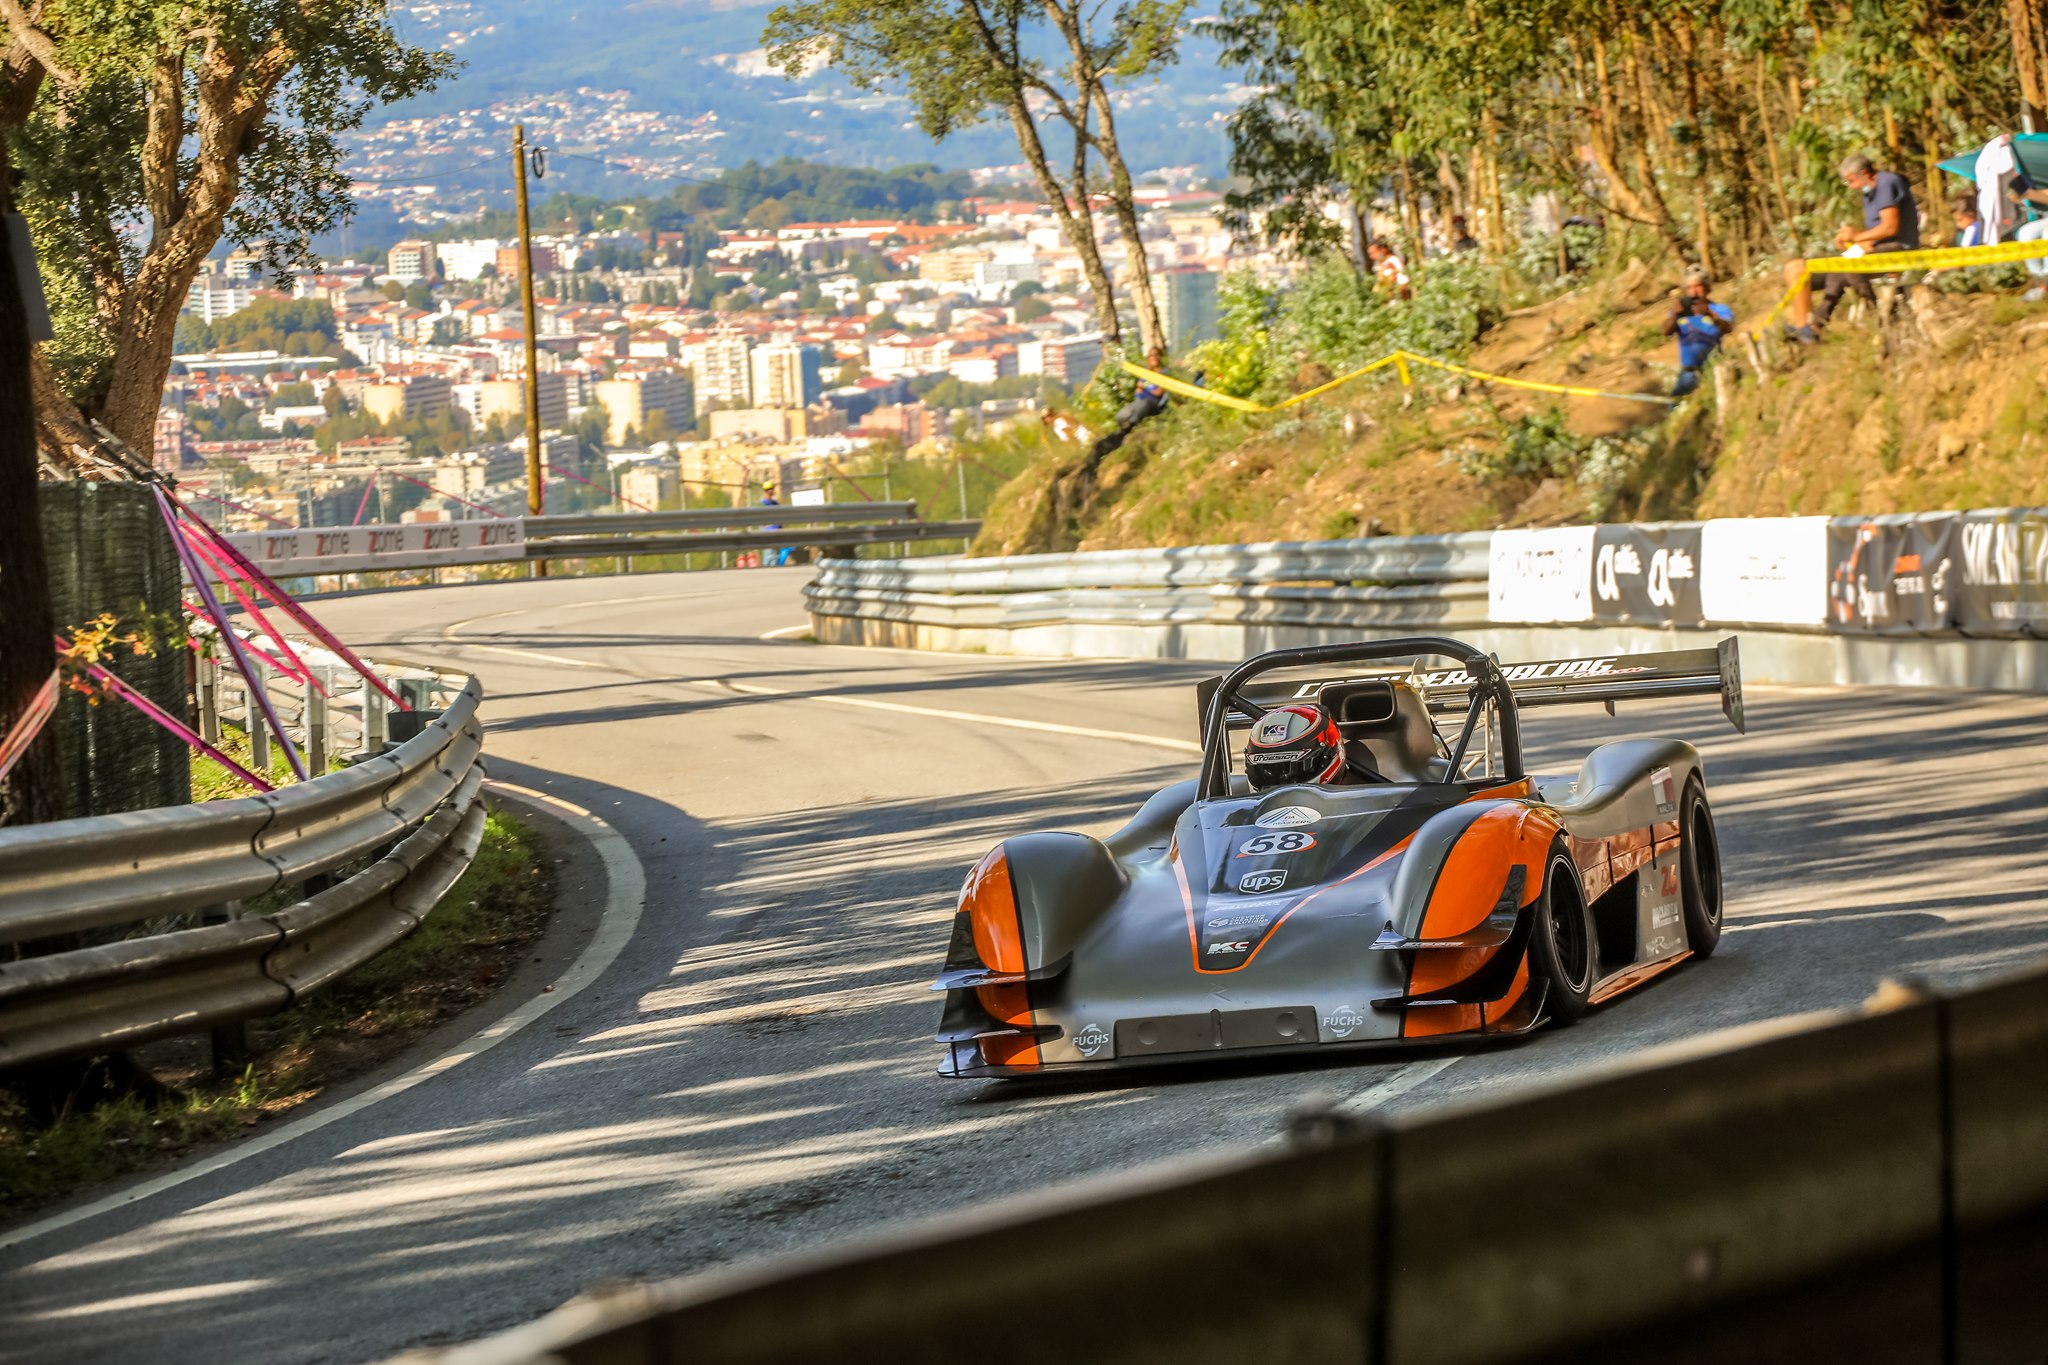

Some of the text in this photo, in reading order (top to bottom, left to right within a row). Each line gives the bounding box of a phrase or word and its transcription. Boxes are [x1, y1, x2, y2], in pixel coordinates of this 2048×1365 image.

[1247, 833, 1305, 854] 58
[1242, 875, 1283, 891] ups
[1323, 1015, 1364, 1027] FUCHS
[1072, 1033, 1109, 1047] FUCHS
